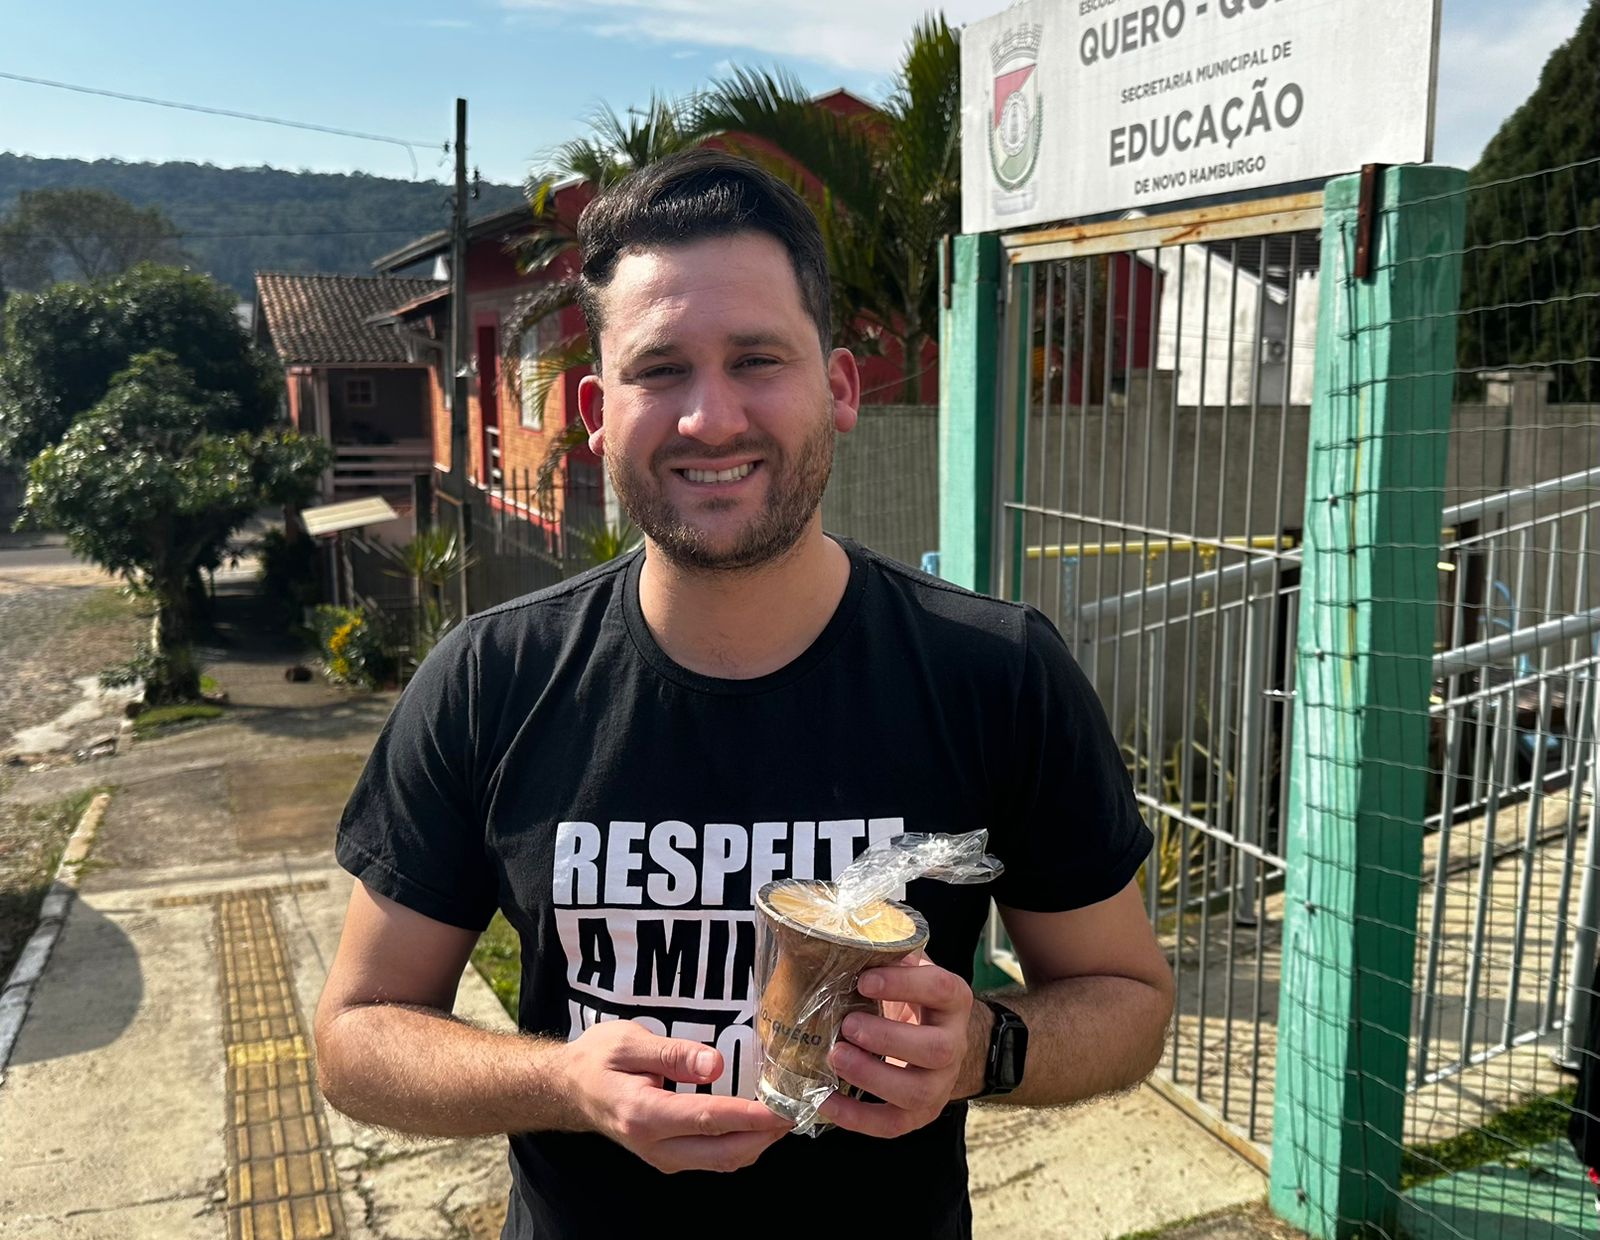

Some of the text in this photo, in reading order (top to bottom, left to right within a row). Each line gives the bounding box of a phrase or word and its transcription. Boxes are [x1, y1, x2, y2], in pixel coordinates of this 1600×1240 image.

[1080, 0, 1185, 66] QUERO
[1121, 40, 1292, 104] SECRETARIA MUNICIPAL DE
[1109, 76, 1304, 167] EDUCAÇÃO
[1135, 155, 1266, 195] DE NOVO HAMBURGO
[577, 918, 616, 992] A
